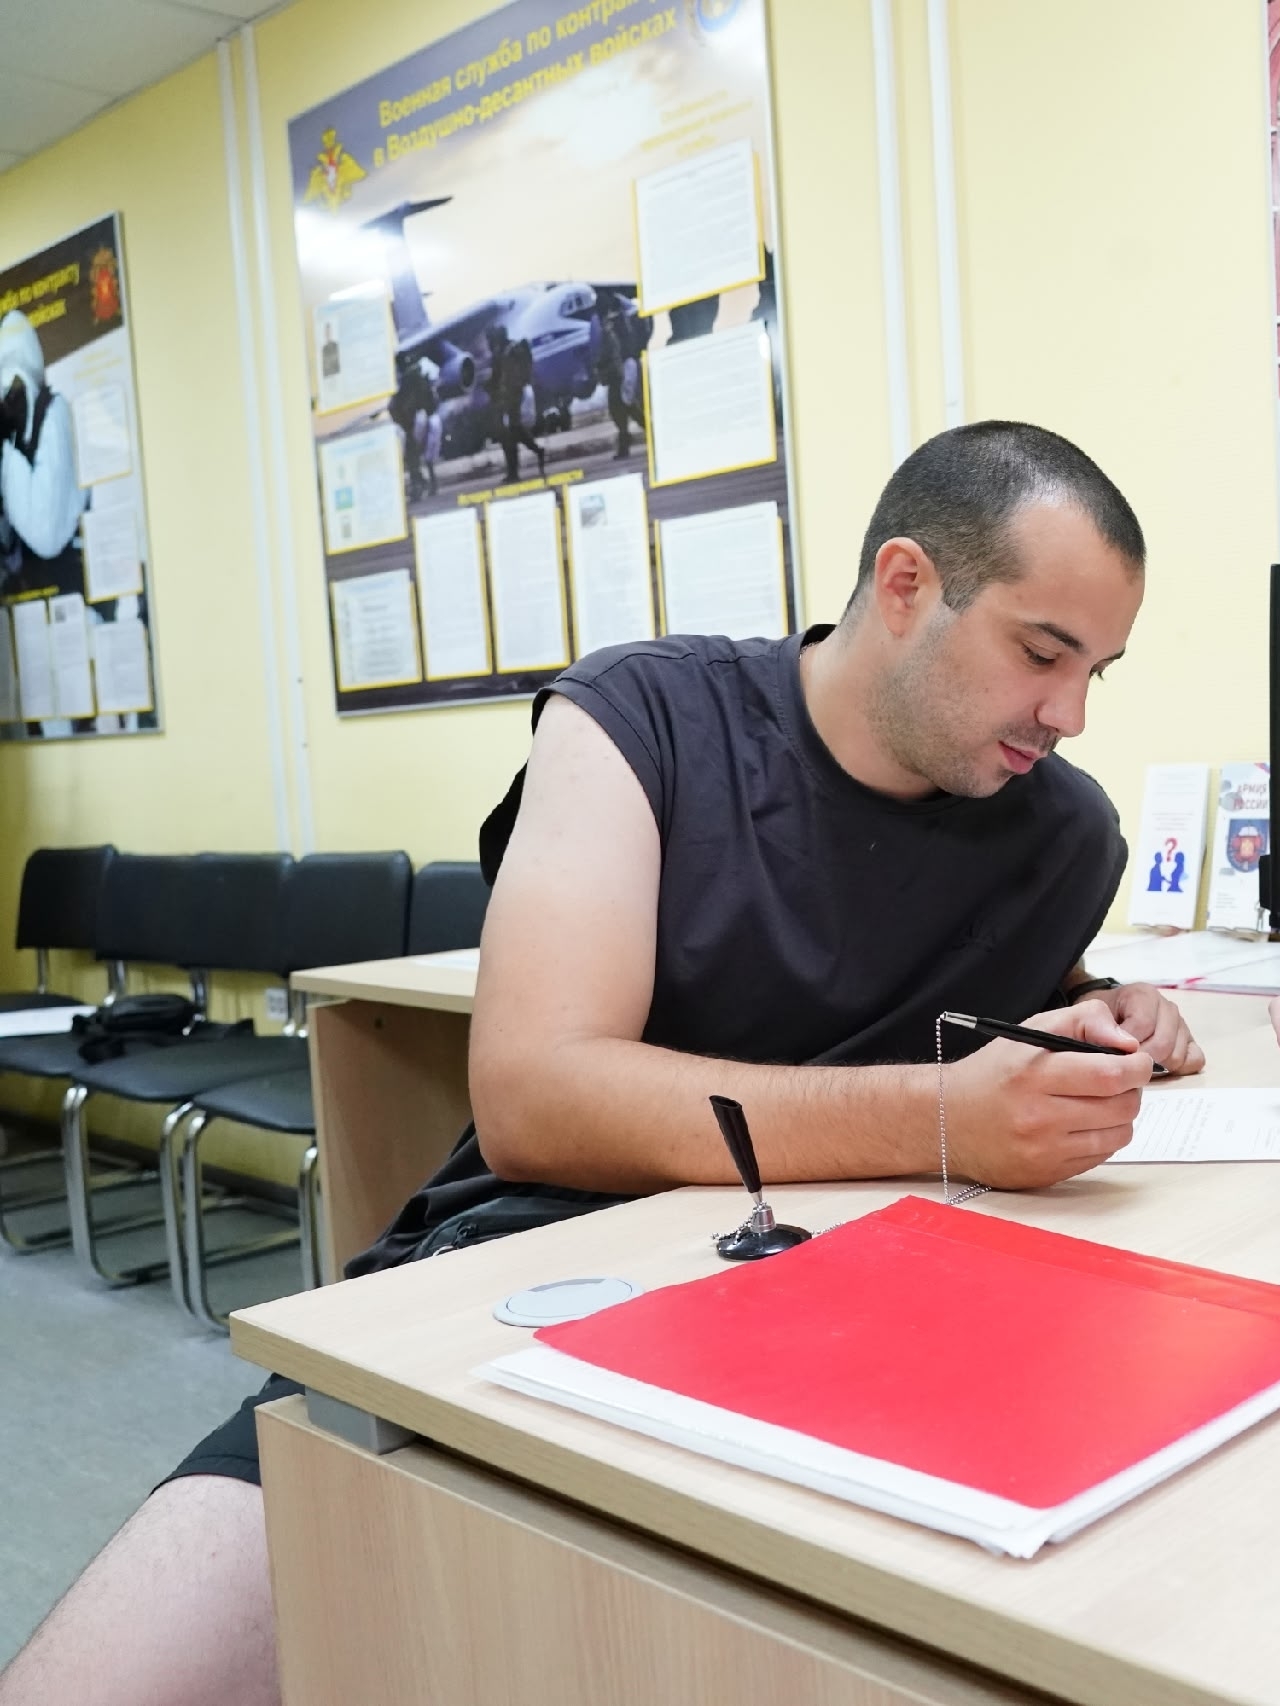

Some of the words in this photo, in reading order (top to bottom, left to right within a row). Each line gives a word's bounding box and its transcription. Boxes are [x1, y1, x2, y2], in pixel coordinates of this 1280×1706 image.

[372, 147, 385, 169] в
[386, 51, 584, 161] Воздушно-десантных
[589, 7, 677, 66] войсках
[379, 75, 451, 128] Военная
[455, 38, 523, 91] служба
[526, 25, 552, 55] по
[555, 0, 655, 41] контра
